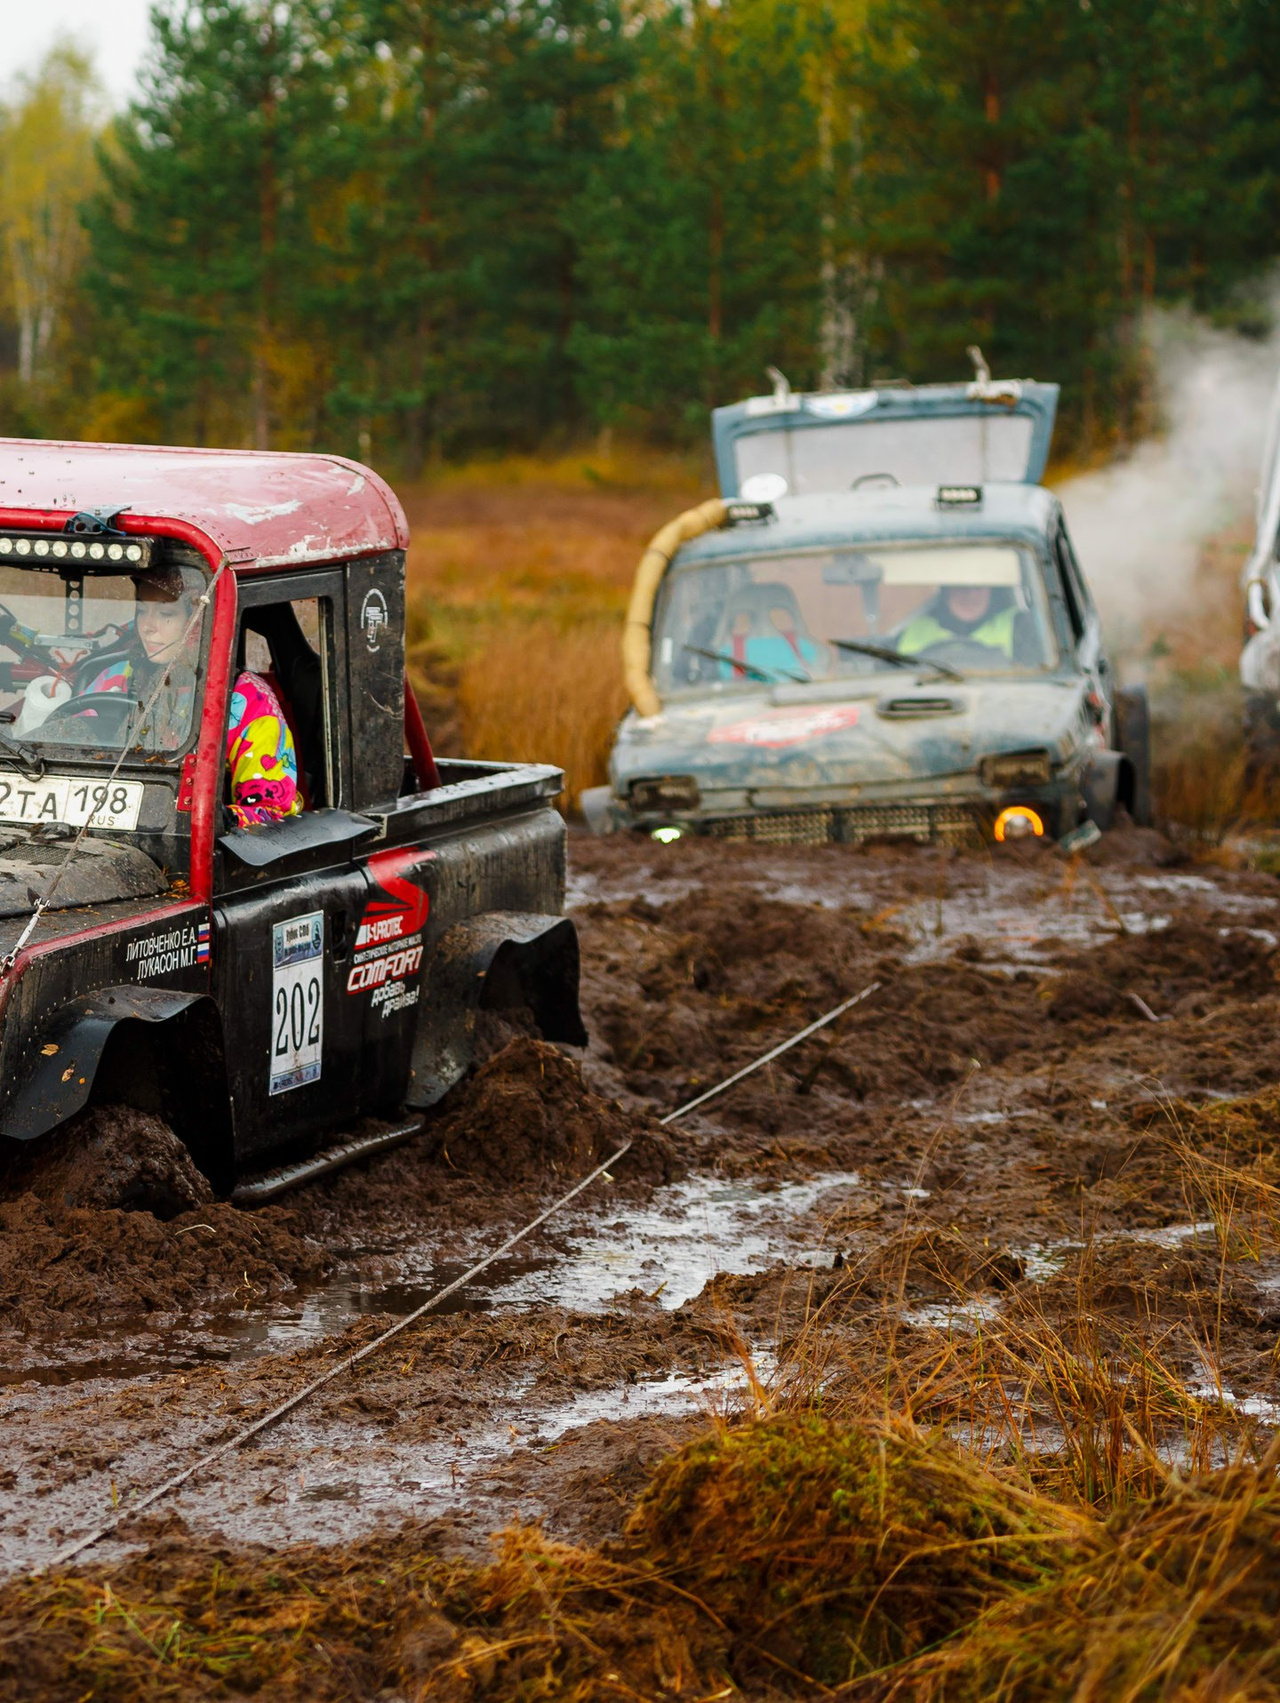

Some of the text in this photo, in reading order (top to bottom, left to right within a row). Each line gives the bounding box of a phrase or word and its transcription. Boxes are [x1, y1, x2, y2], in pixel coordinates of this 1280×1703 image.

[73, 785, 128, 815] 198
[88, 815, 116, 827] RUS
[125, 926, 198, 962] ЛИТОВЧЕНКО Е.А.
[136, 945, 197, 980] ЛУКАСОН М.Г.
[347, 945, 424, 993] COMFORT
[370, 980, 406, 1008] добавь
[276, 977, 320, 1057] 202
